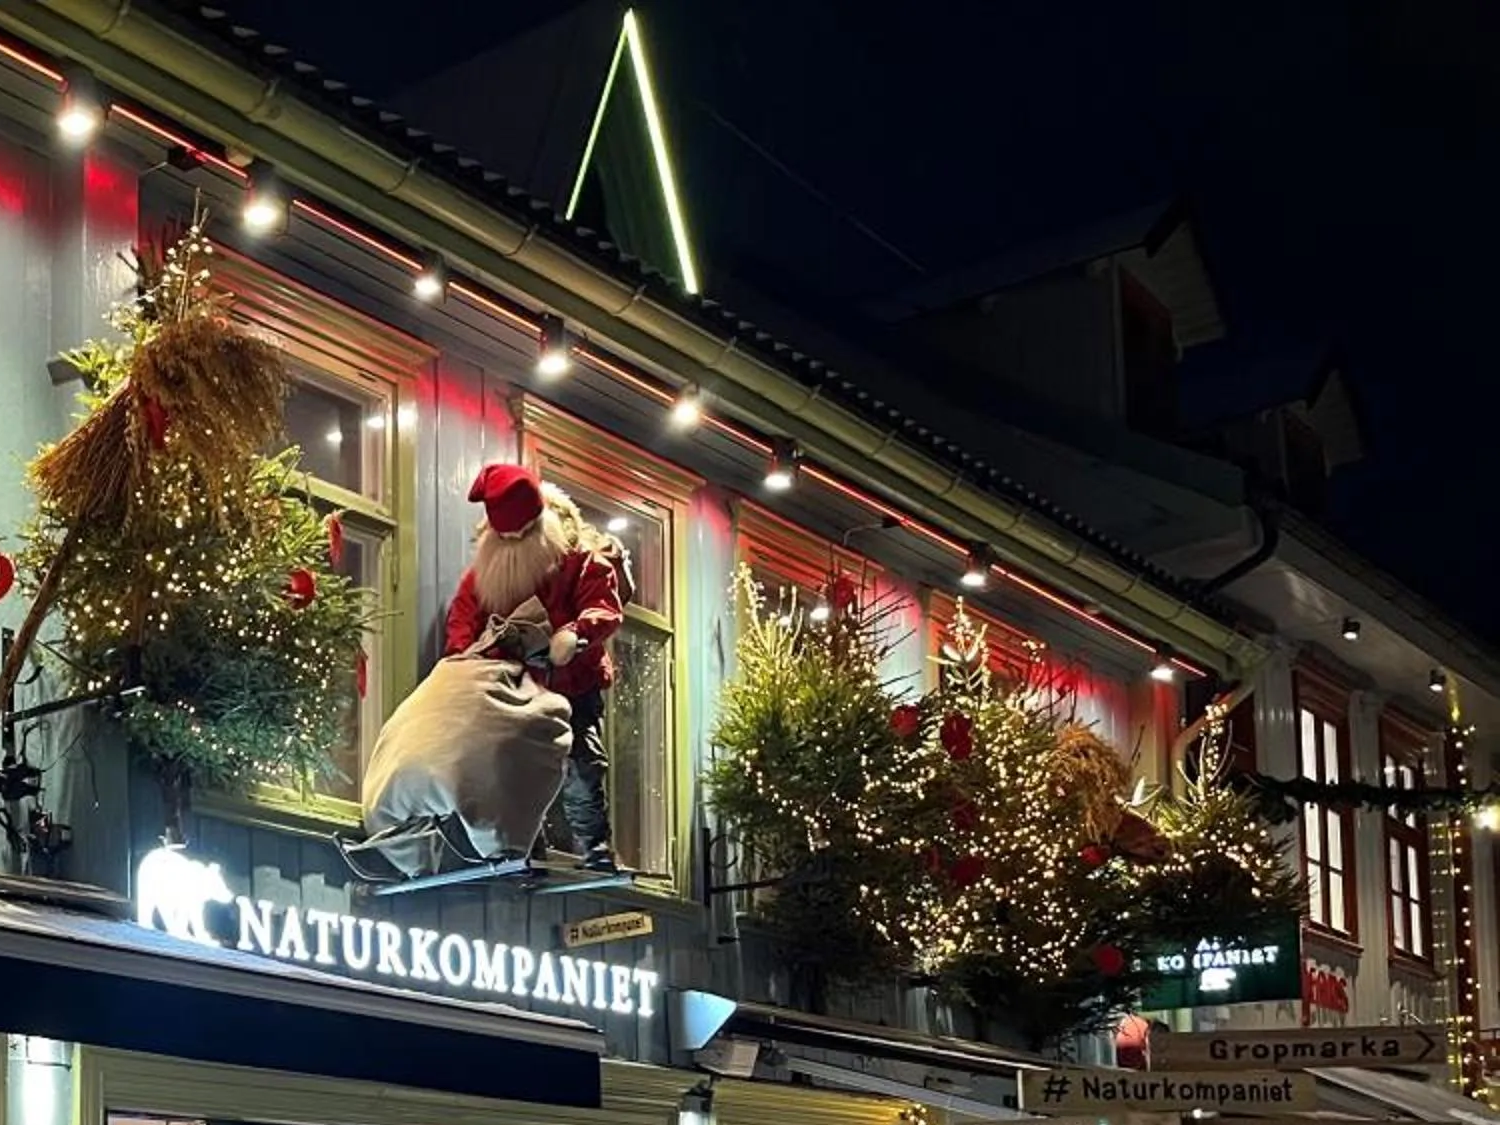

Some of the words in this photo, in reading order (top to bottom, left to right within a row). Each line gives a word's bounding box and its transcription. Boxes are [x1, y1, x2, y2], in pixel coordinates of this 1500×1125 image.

[235, 895, 659, 1018] NATURKOMPANIET
[1209, 1036, 1400, 1063] Gropmarka
[1082, 1077, 1293, 1105] Naturkompaniet
